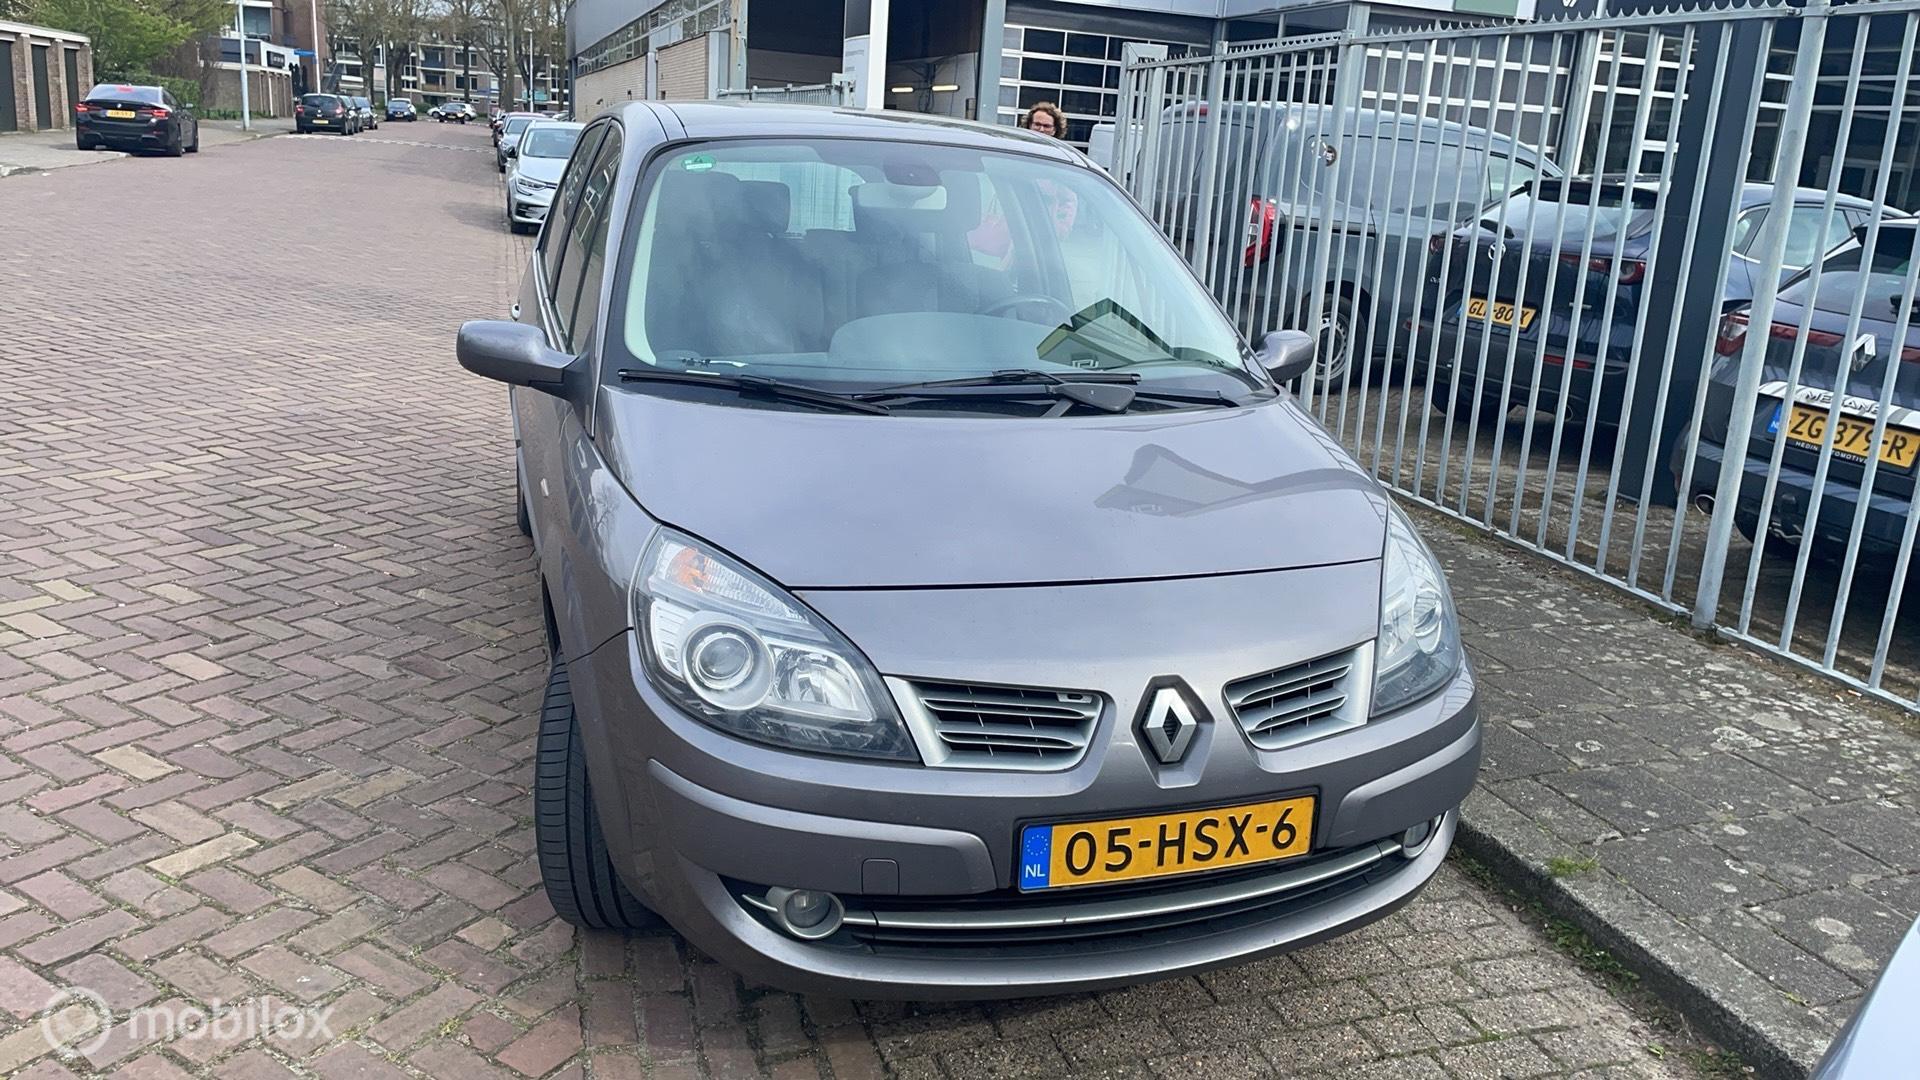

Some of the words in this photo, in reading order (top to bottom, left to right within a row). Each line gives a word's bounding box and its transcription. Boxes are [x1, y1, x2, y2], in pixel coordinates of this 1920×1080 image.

[1469, 300, 1530, 325] GL-80X
[1805, 390, 1880, 415] MEANE
[1790, 411, 1908, 461] ZG379-R
[1795, 440, 1819, 451] HEDIN
[1025, 864, 1046, 878] NL
[1064, 808, 1297, 876] 05-HSX-6
